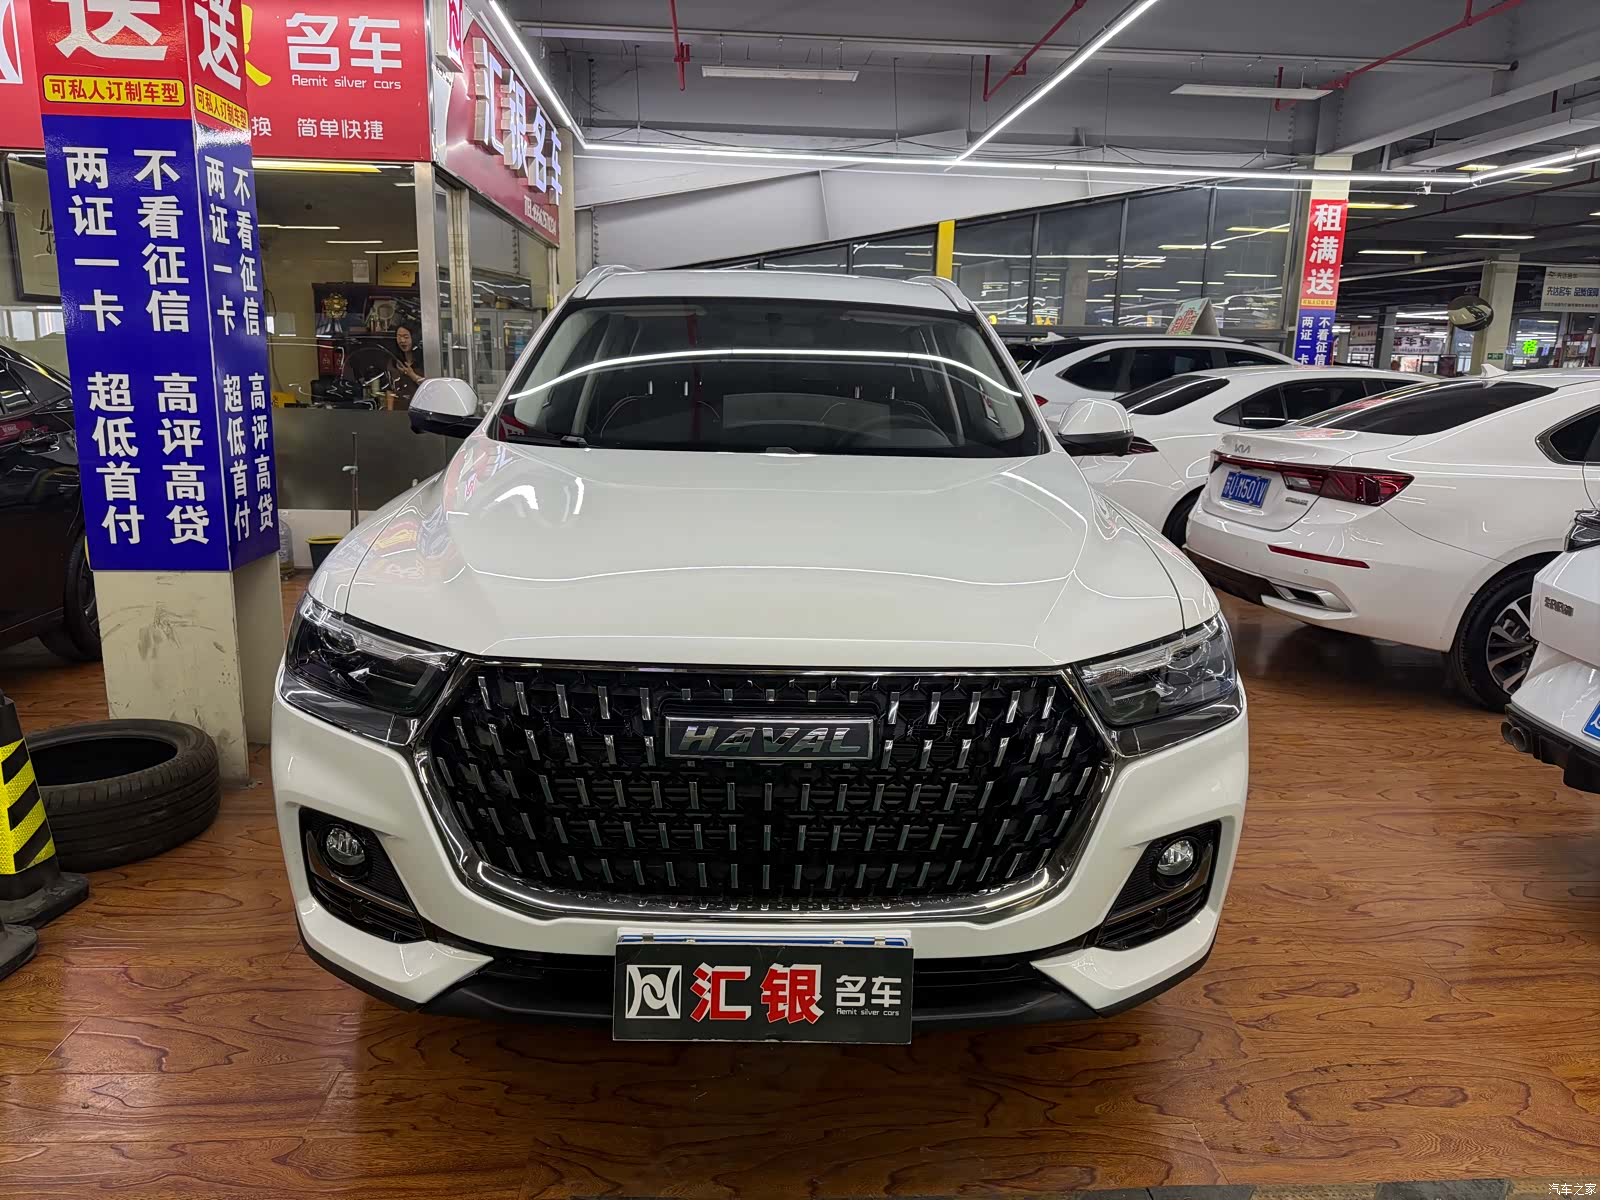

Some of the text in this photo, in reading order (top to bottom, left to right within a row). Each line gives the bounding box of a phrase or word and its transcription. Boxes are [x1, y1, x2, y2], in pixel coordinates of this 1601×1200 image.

[286, 13, 402, 74] 名车
[49, 78, 180, 103] 可私人订制车型
[196, 88, 248, 131] 可私人订制车型
[292, 74, 402, 90] Remit silver cars
[297, 117, 384, 141] 简单快捷
[474, 37, 563, 206] 汇银名车
[1306, 203, 1342, 296] 租满送
[62, 146, 145, 545] 两证一卡 超低首付
[133, 149, 210, 545] 不看征信 高评高贷
[204, 155, 251, 542] 两证一卡 超低首付
[232, 166, 274, 533] 不看征信 高评高贷
[678, 725, 861, 753] HAVAL
[836, 1007, 900, 1017] Remit silver cars
